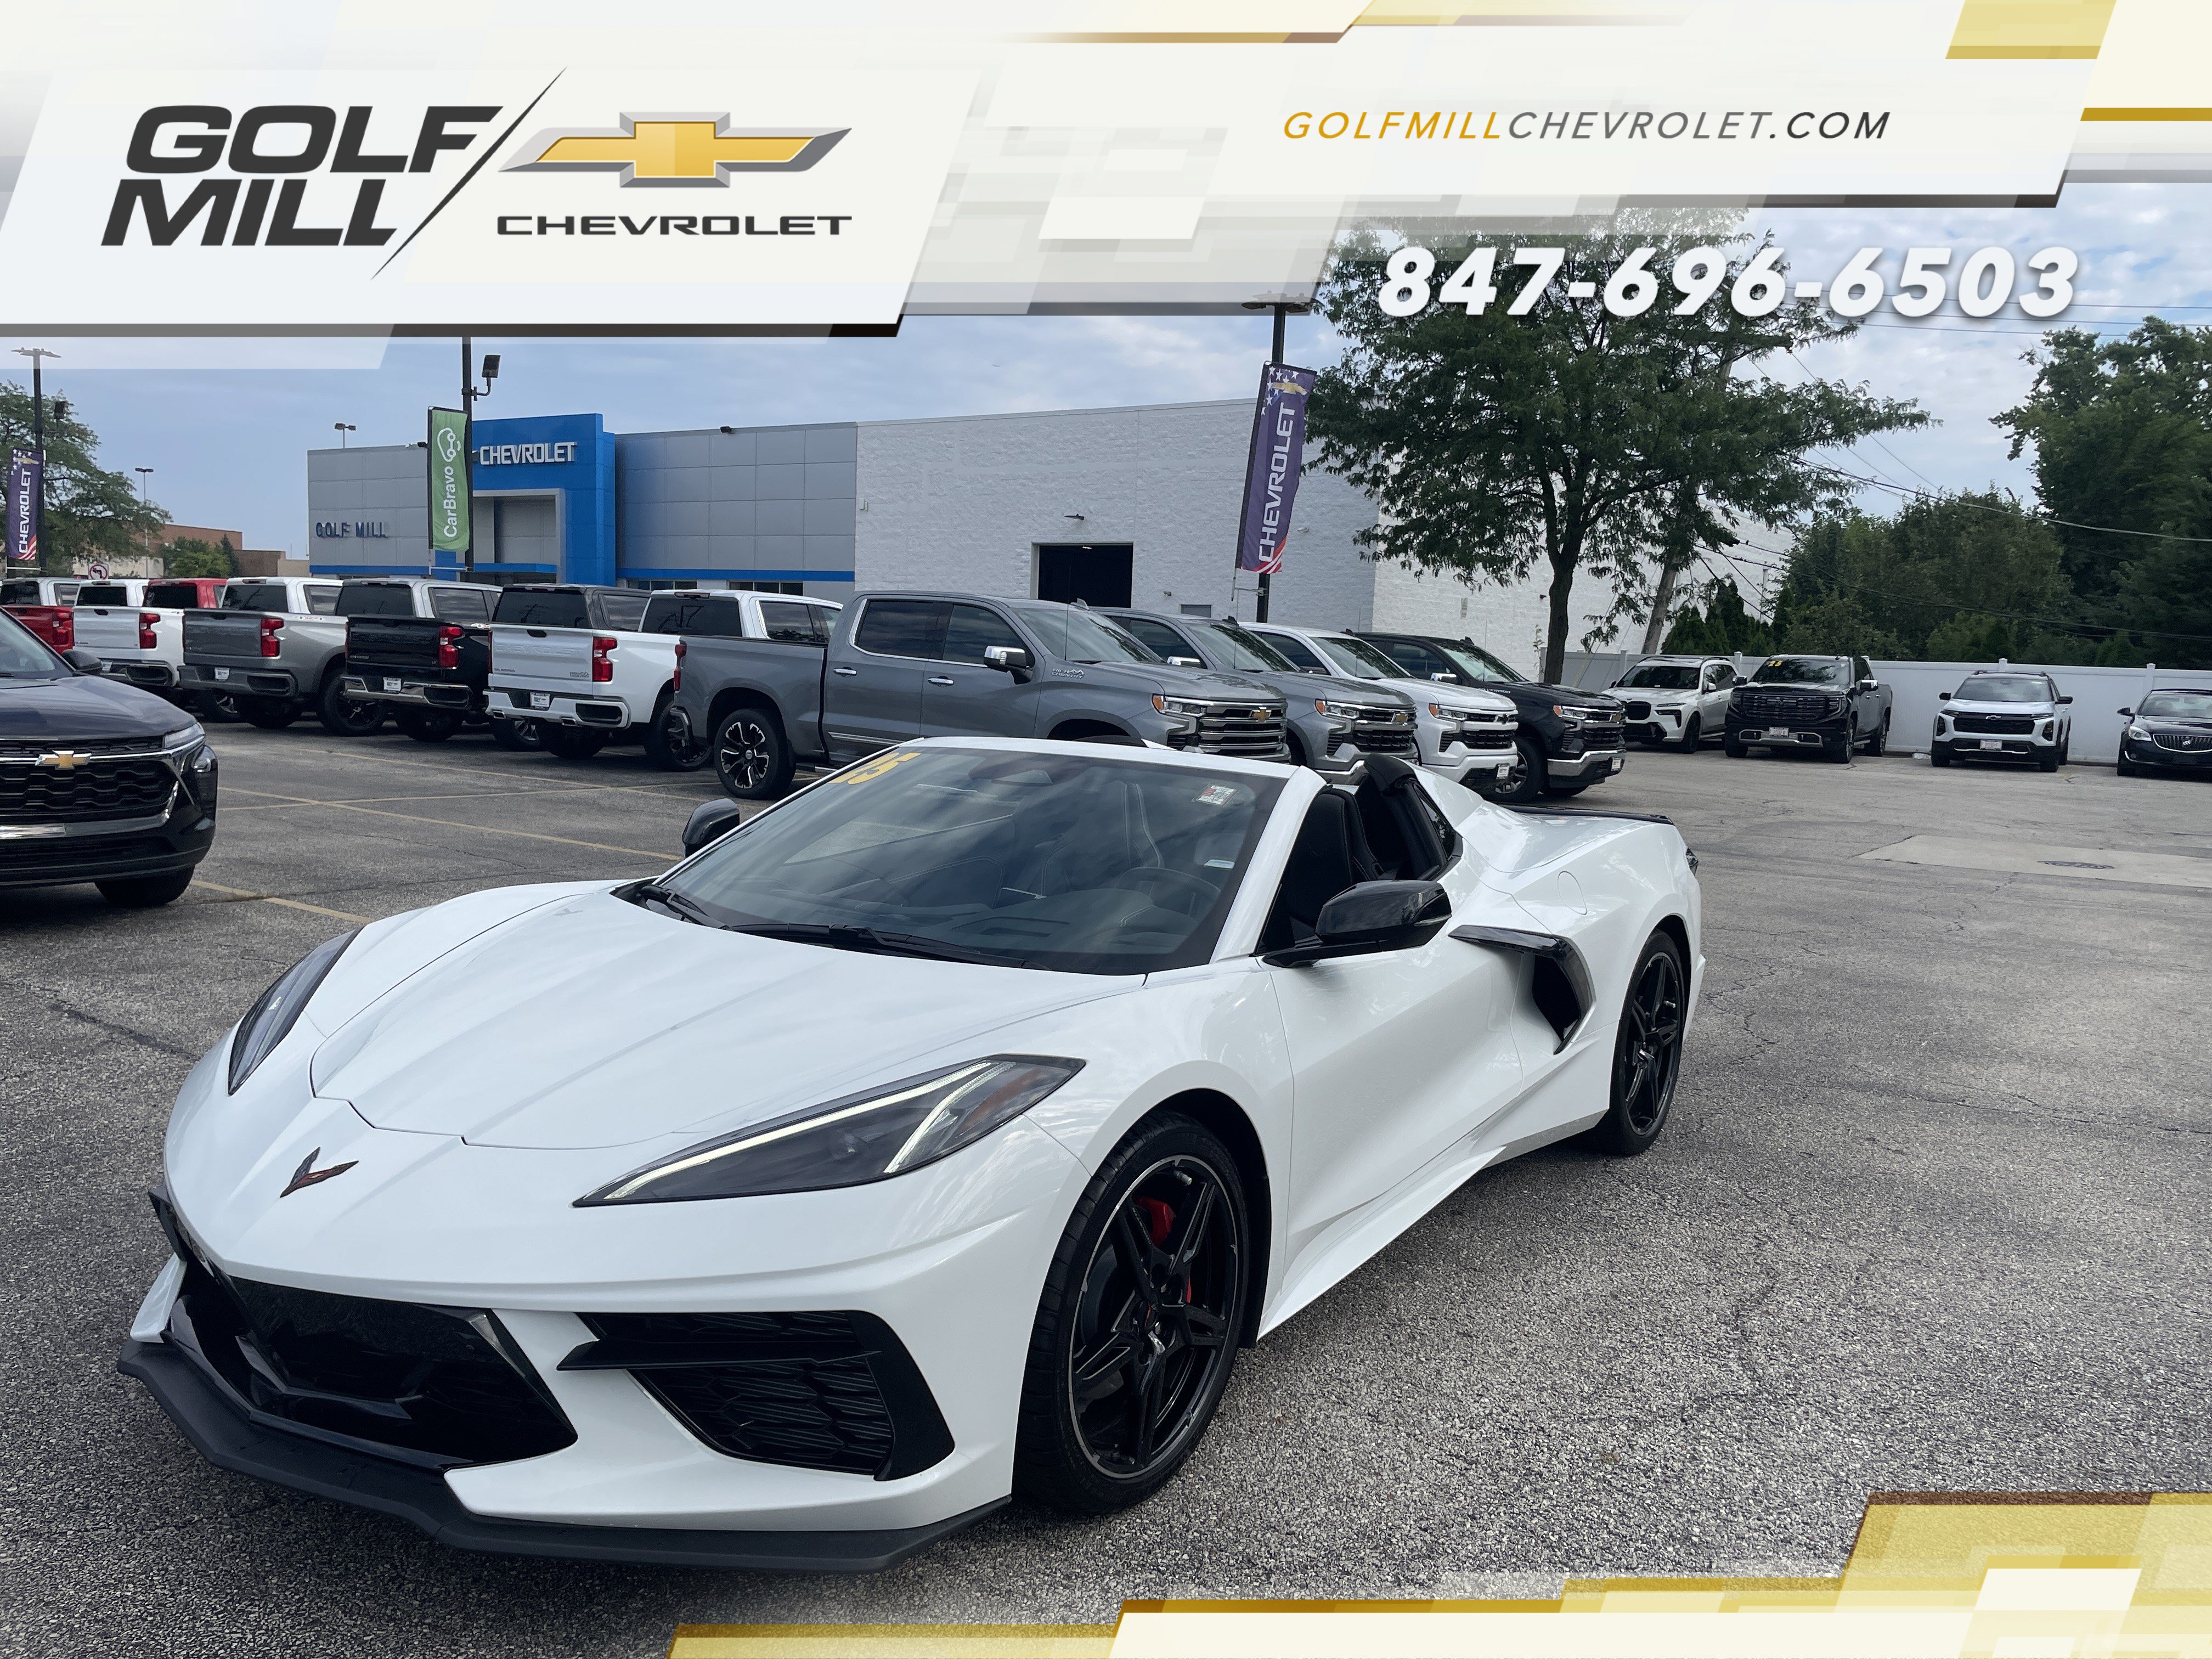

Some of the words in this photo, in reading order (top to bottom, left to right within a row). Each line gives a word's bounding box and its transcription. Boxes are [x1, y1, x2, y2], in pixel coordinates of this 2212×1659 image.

[480, 442, 577, 465] CHEVROLET
[1259, 402, 1295, 562] CHEVROLET
[19, 468, 31, 554] CHEVROLET
[316, 522, 351, 538] GOLF
[356, 522, 386, 538] MILL
[443, 466, 458, 537] CarBravo
